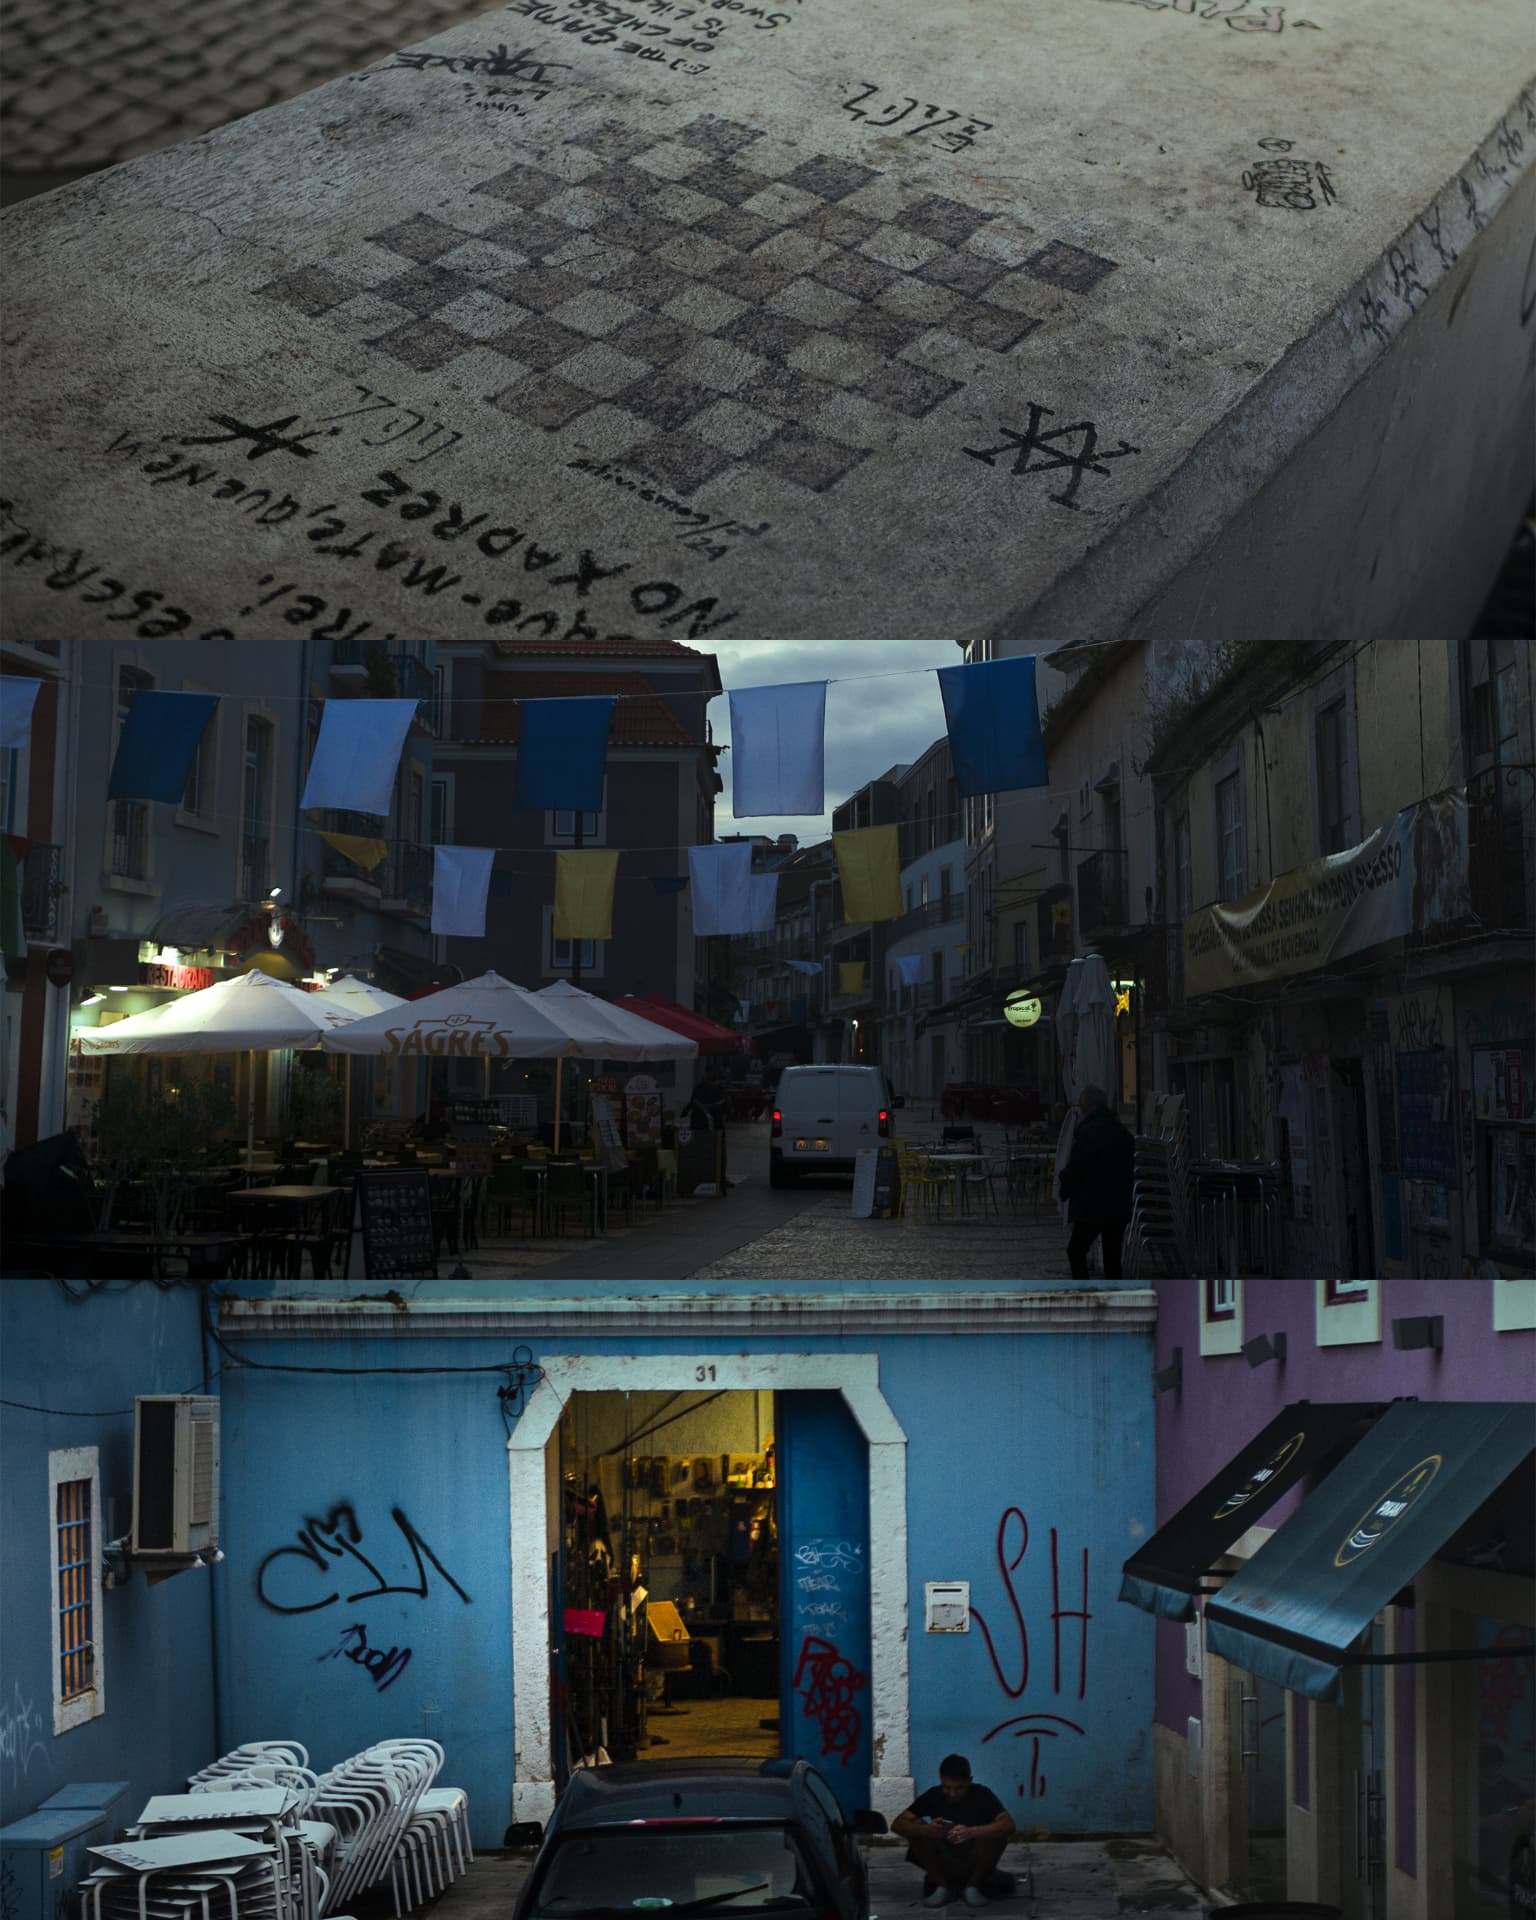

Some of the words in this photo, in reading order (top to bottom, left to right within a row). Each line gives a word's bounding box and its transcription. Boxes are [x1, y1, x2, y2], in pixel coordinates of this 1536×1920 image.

[506, 0, 618, 46] GAME
[664, 38, 715, 53] OF
[630, 582, 739, 639] NO
[380, 1027, 513, 1057] SAGRES
[695, 1364, 717, 1383] 31
